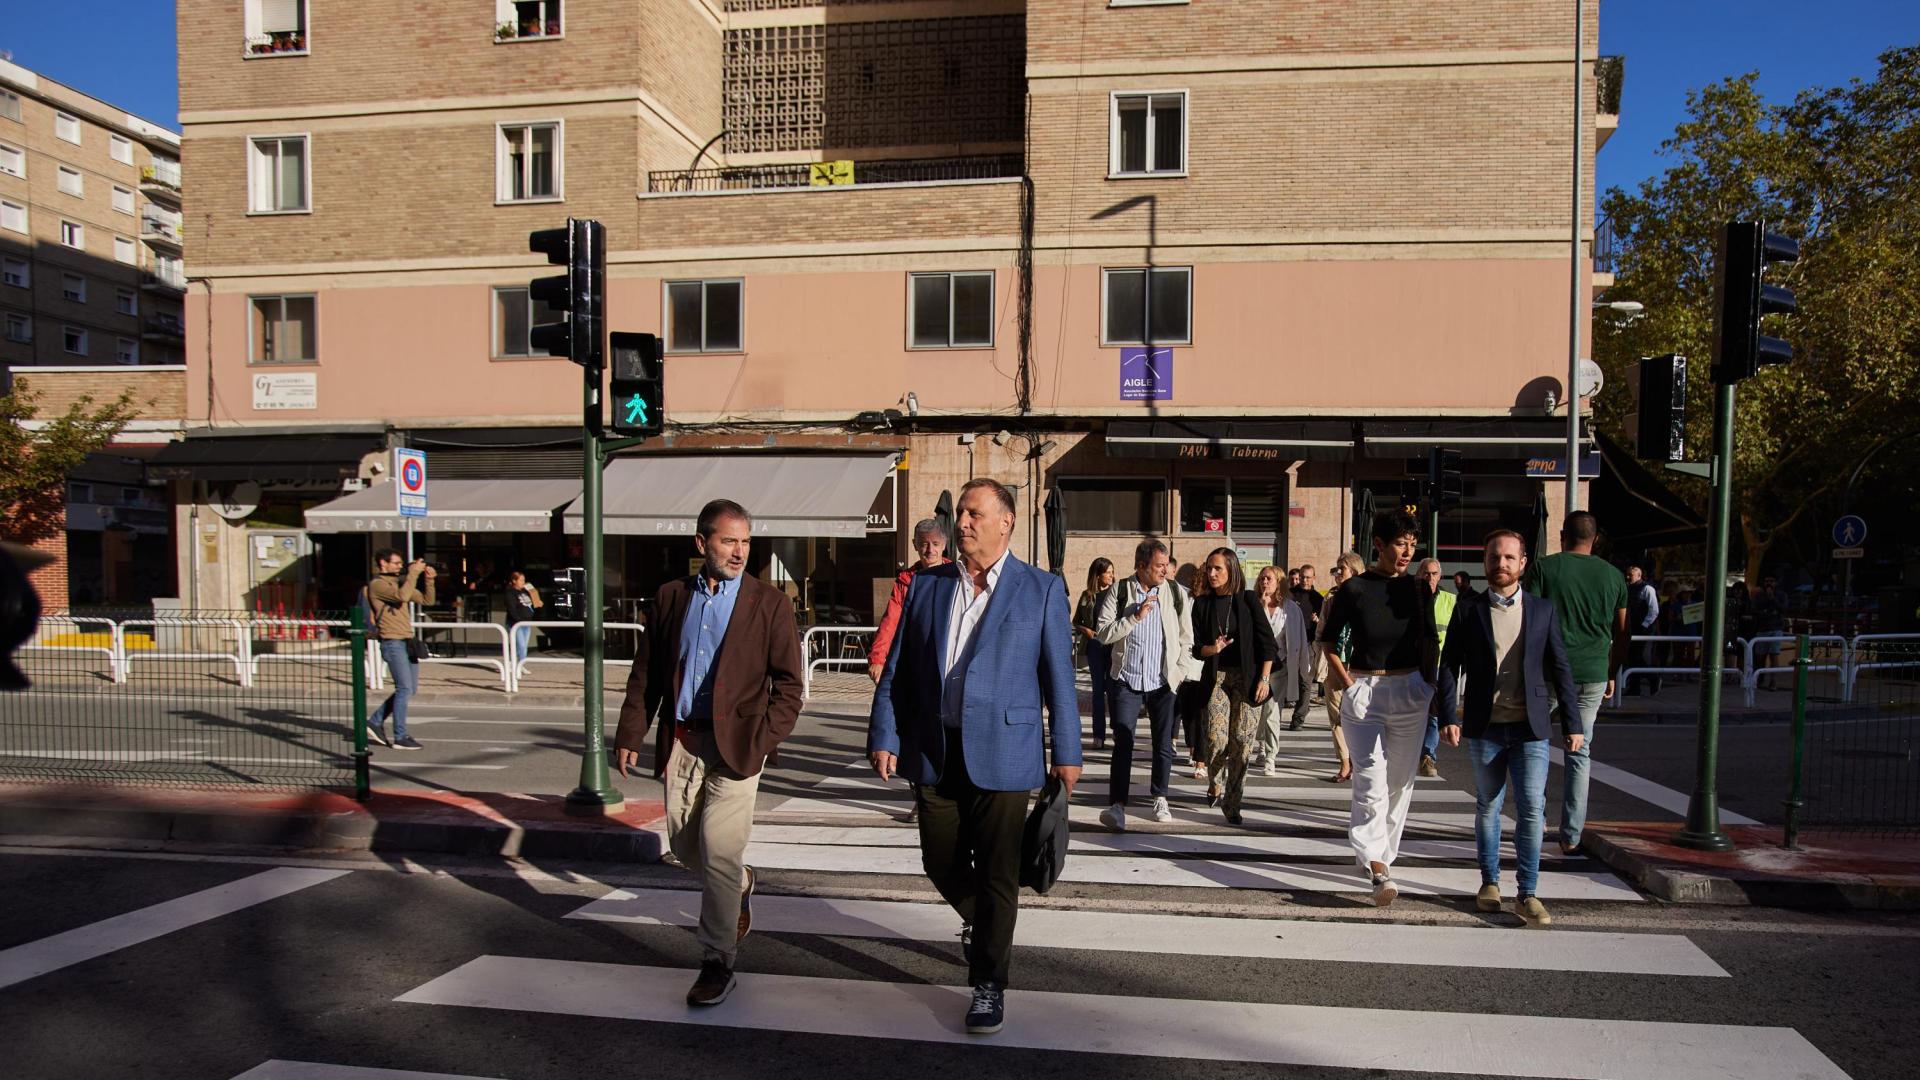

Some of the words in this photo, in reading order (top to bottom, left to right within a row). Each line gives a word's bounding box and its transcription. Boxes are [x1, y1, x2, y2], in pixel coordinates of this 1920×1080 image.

[1123, 378, 1153, 387] AIGLE
[1179, 444, 1215, 457] PAYV
[1232, 446, 1278, 459] Taberna
[355, 517, 495, 531] PASTELERÍA
[866, 514, 889, 524] RIA
[656, 521, 769, 532] PASTÍA
